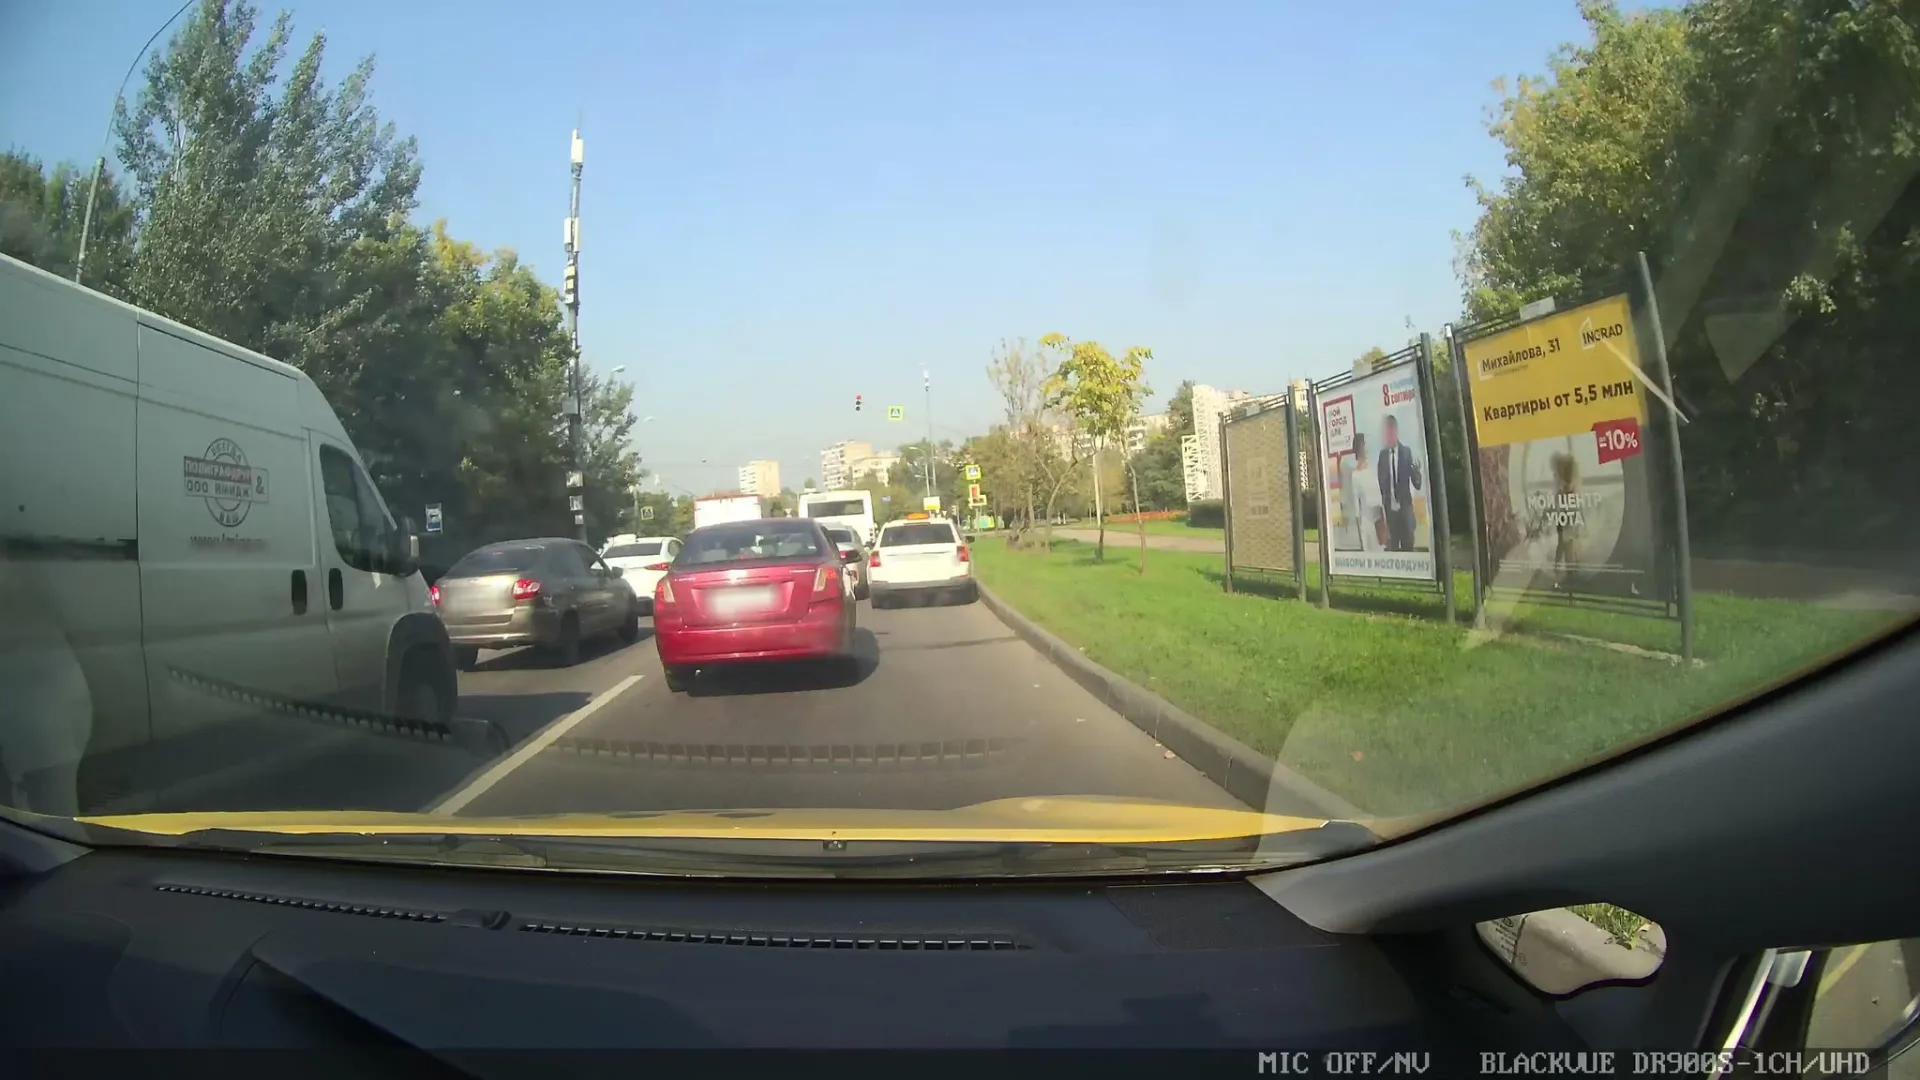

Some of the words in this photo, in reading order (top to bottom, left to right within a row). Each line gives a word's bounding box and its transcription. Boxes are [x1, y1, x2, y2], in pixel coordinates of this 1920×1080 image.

[1583, 323, 1623, 345] INGRAD
[1482, 346, 1546, 372] Михайлова,
[1548, 338, 1561, 353] 31
[1382, 383, 1390, 407] 8
[1484, 397, 1551, 421] Квартиры
[1555, 393, 1570, 409] от
[1574, 385, 1598, 405] 5,5
[1602, 380, 1634, 400] млн
[186, 479, 208, 493] ООО
[1528, 490, 1555, 510] МОЙ
[1558, 490, 1602, 510] ЦЕНТР
[1546, 512, 1584, 527] УЮТА
